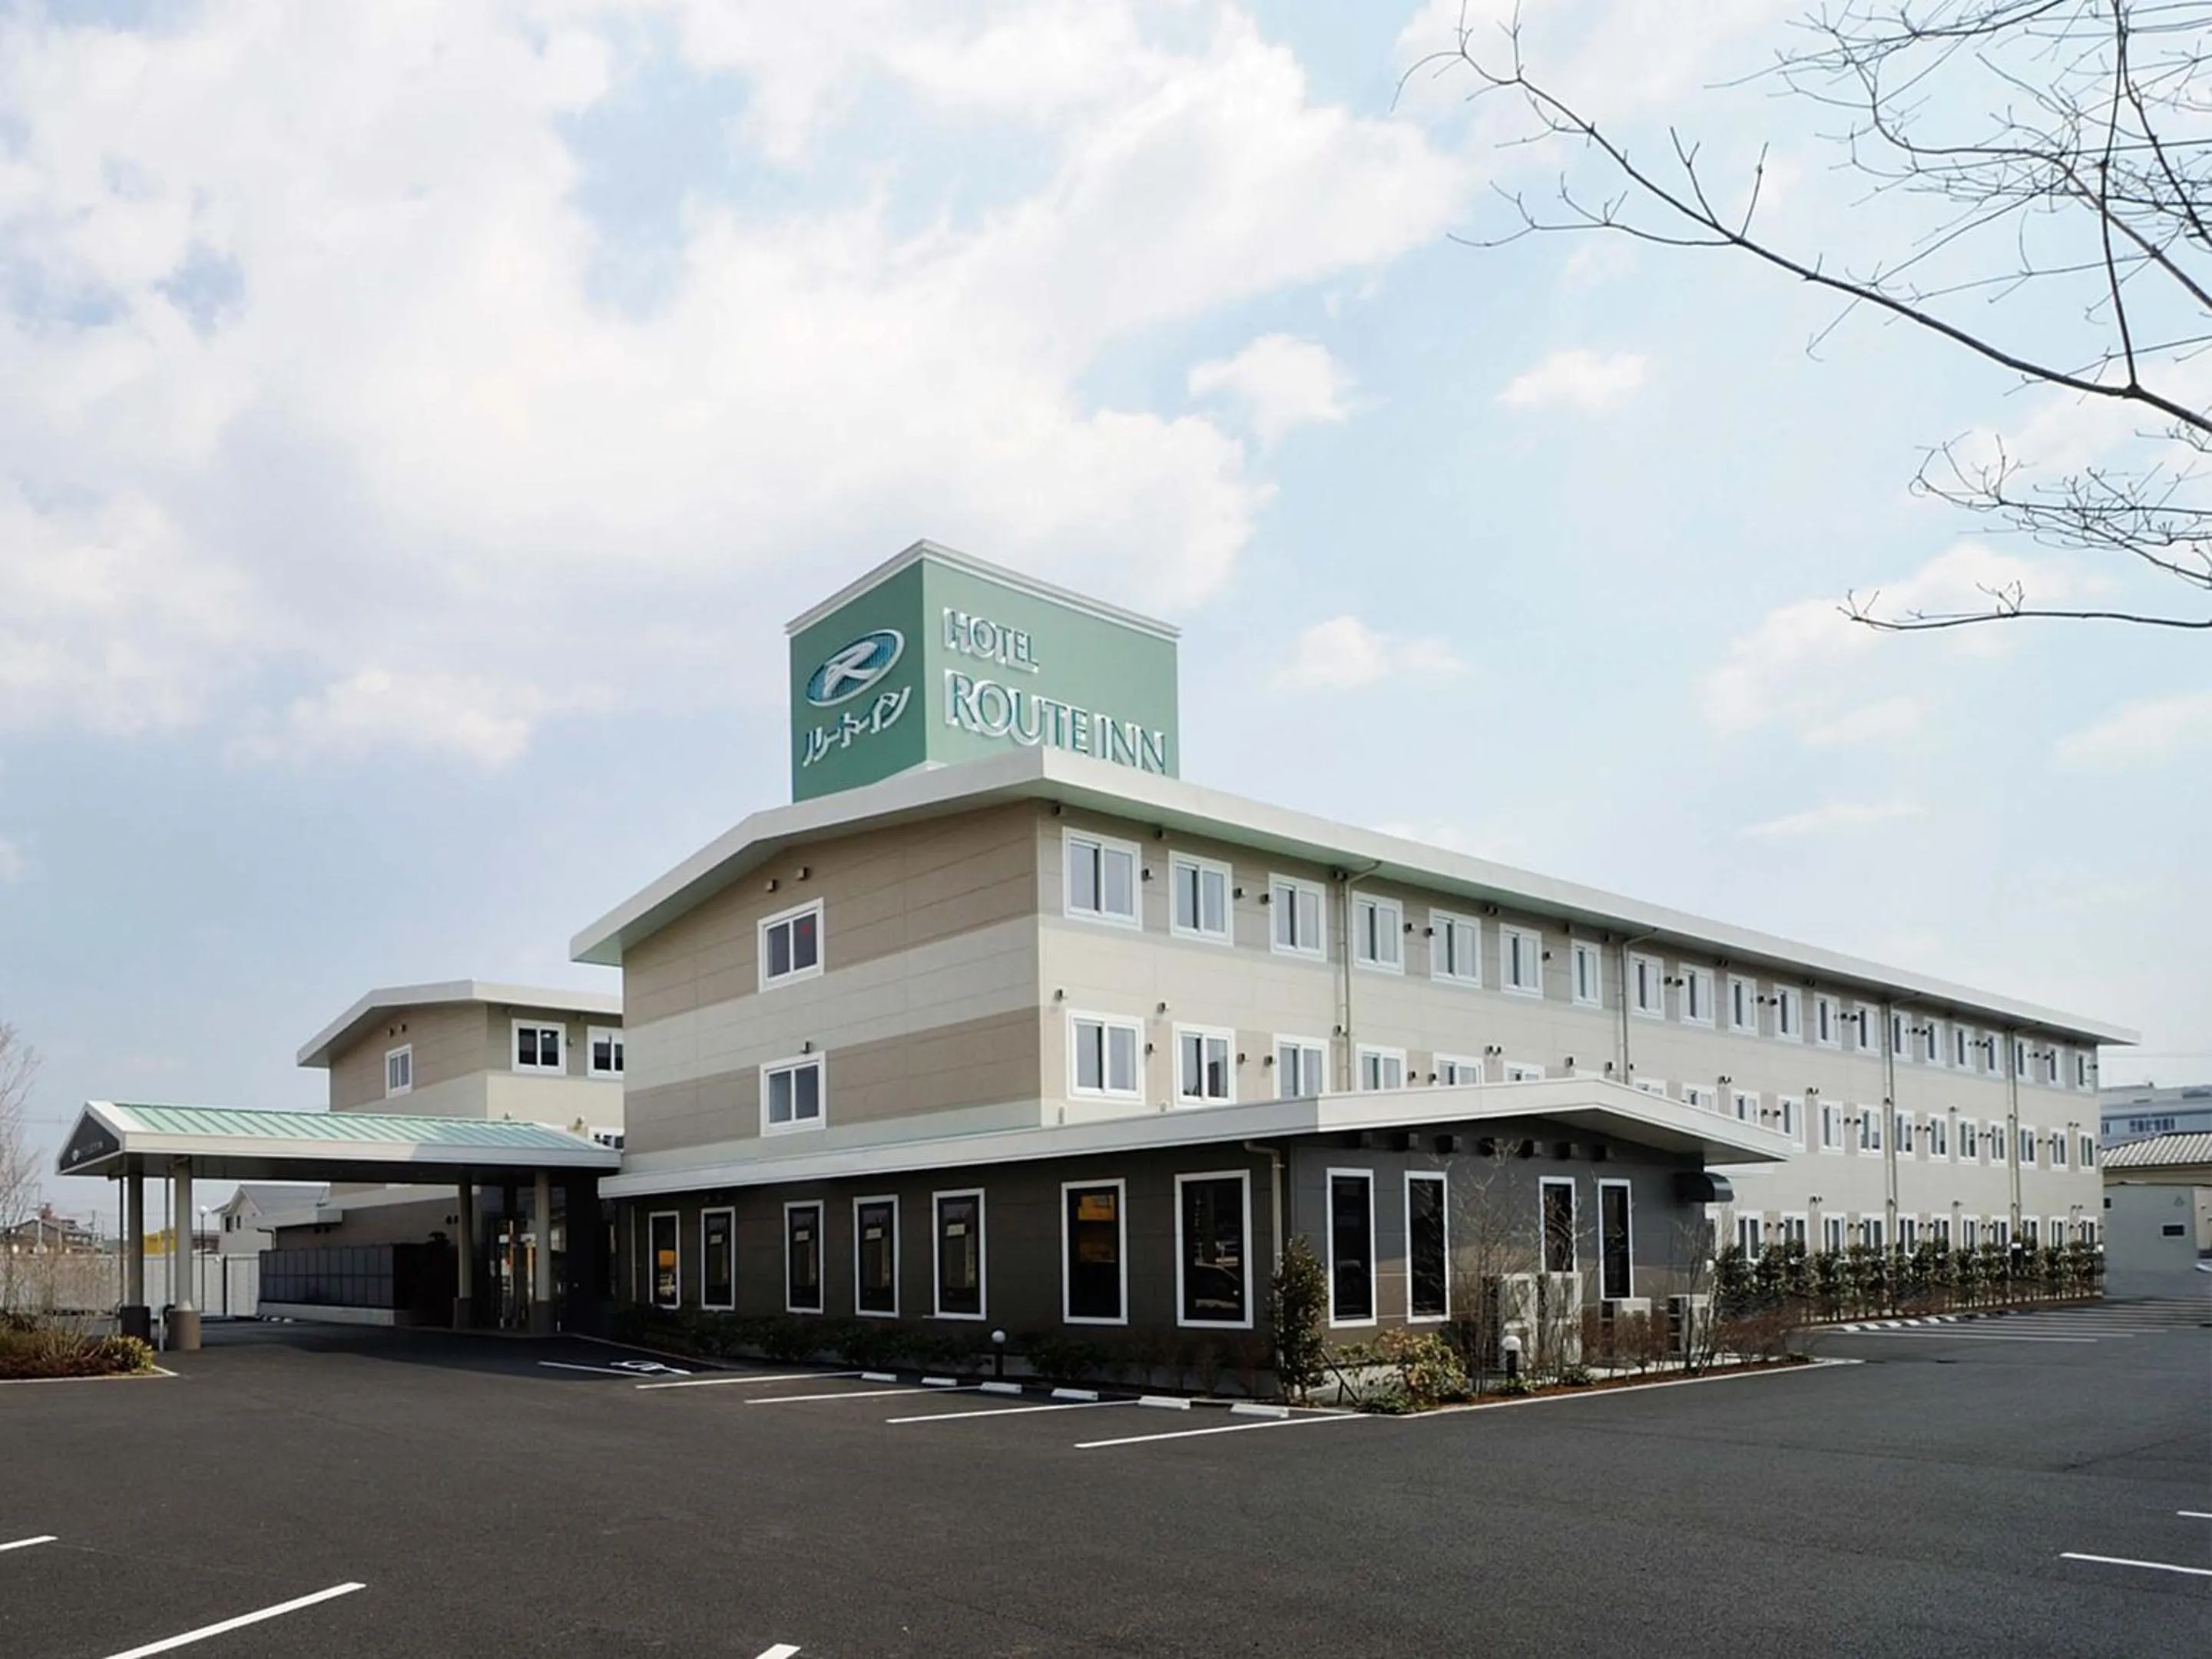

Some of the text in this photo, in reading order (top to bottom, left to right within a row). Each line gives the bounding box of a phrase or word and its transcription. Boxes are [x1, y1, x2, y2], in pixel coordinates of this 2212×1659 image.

[943, 606, 1039, 674] HOTEL
[802, 685, 912, 767] ルートイン
[943, 667, 1166, 776] ROUTE INN
